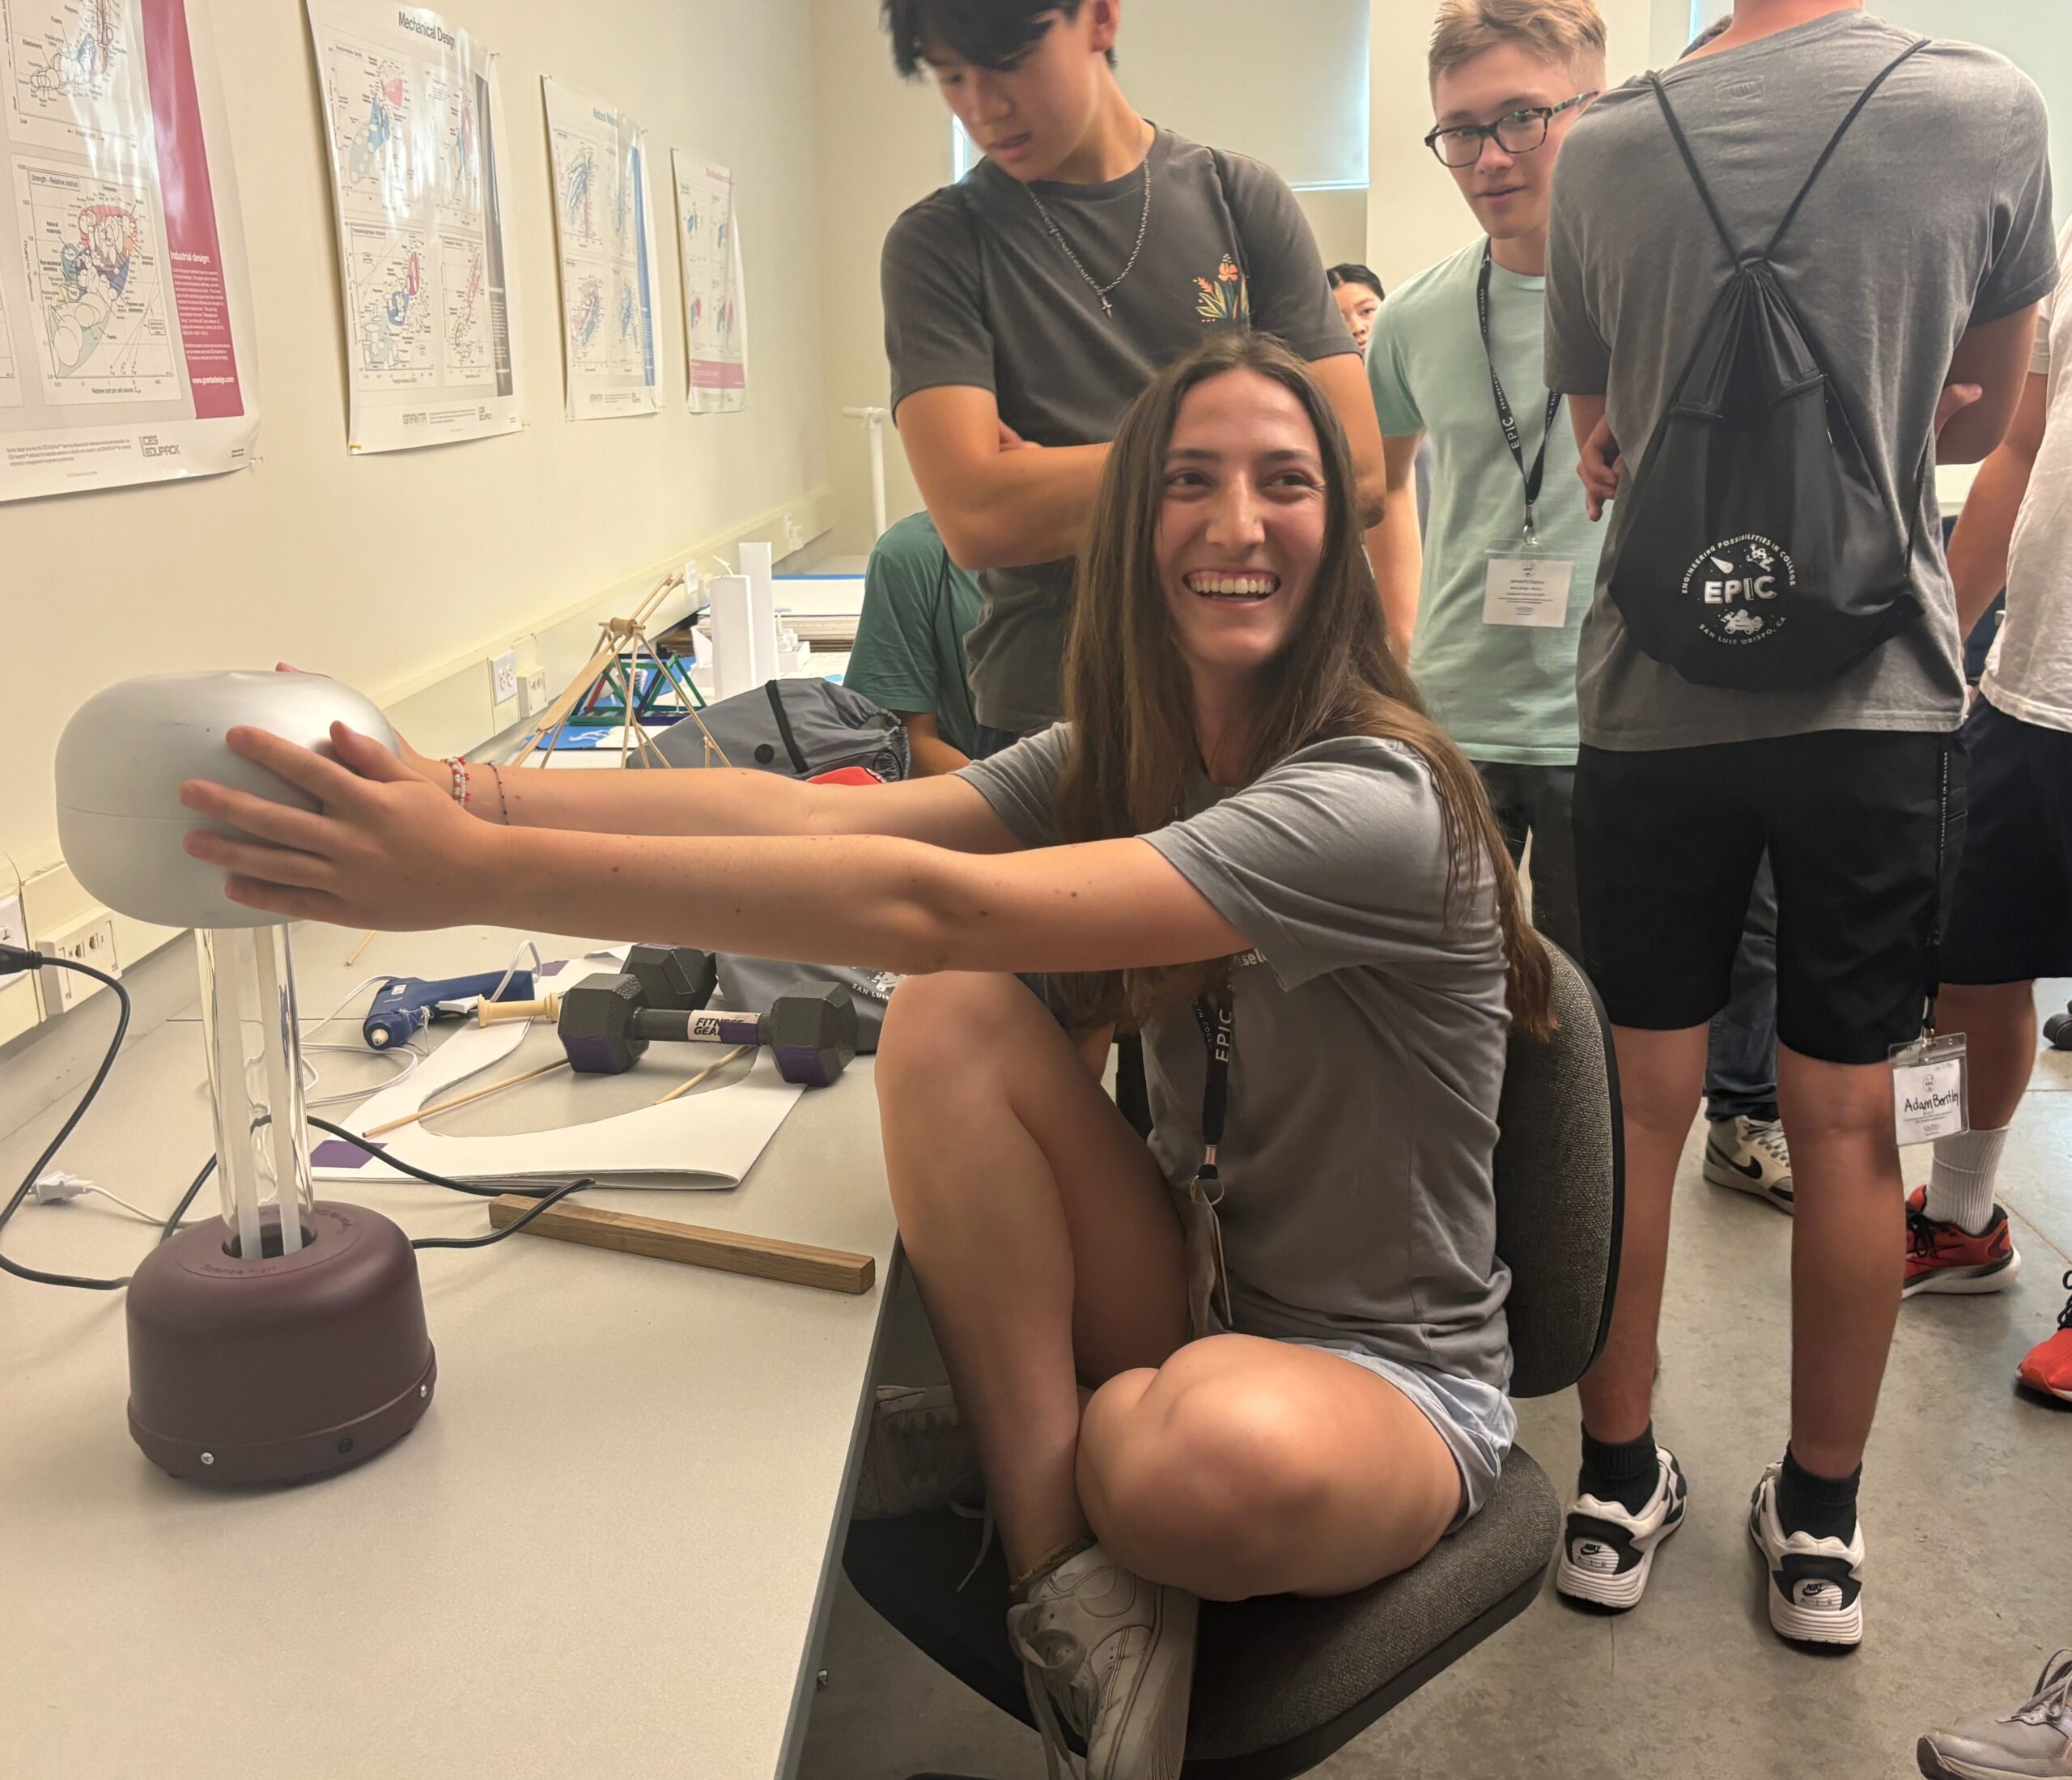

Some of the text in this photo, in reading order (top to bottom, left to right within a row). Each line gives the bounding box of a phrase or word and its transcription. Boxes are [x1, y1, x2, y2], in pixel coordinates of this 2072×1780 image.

[398, 11, 455, 50] Mechanical Design
[170, 250, 210, 266] Industrial design:
[142, 435, 159, 446] CES
[1502, 416, 1520, 450] EPIC
[145, 444, 180, 457] EDUPACK
[1682, 533, 1796, 594] ENGINEERING POSSIBILITIES IN COLLEGE
[1704, 576, 1777, 604] EPIC
[1699, 624, 1716, 639] SAN
[1717, 635, 1738, 645] LUIS
[1776, 617, 1787, 627] CA
[851, 983, 869, 996] SAN
[694, 1026, 720, 1036] GEA
[1215, 1008, 1232, 1063] EPIC
[1904, 1096, 1933, 1113] Adam
[1806, 1582, 1824, 1592] NIKE
[1799, 1596, 1833, 1607] AIR
